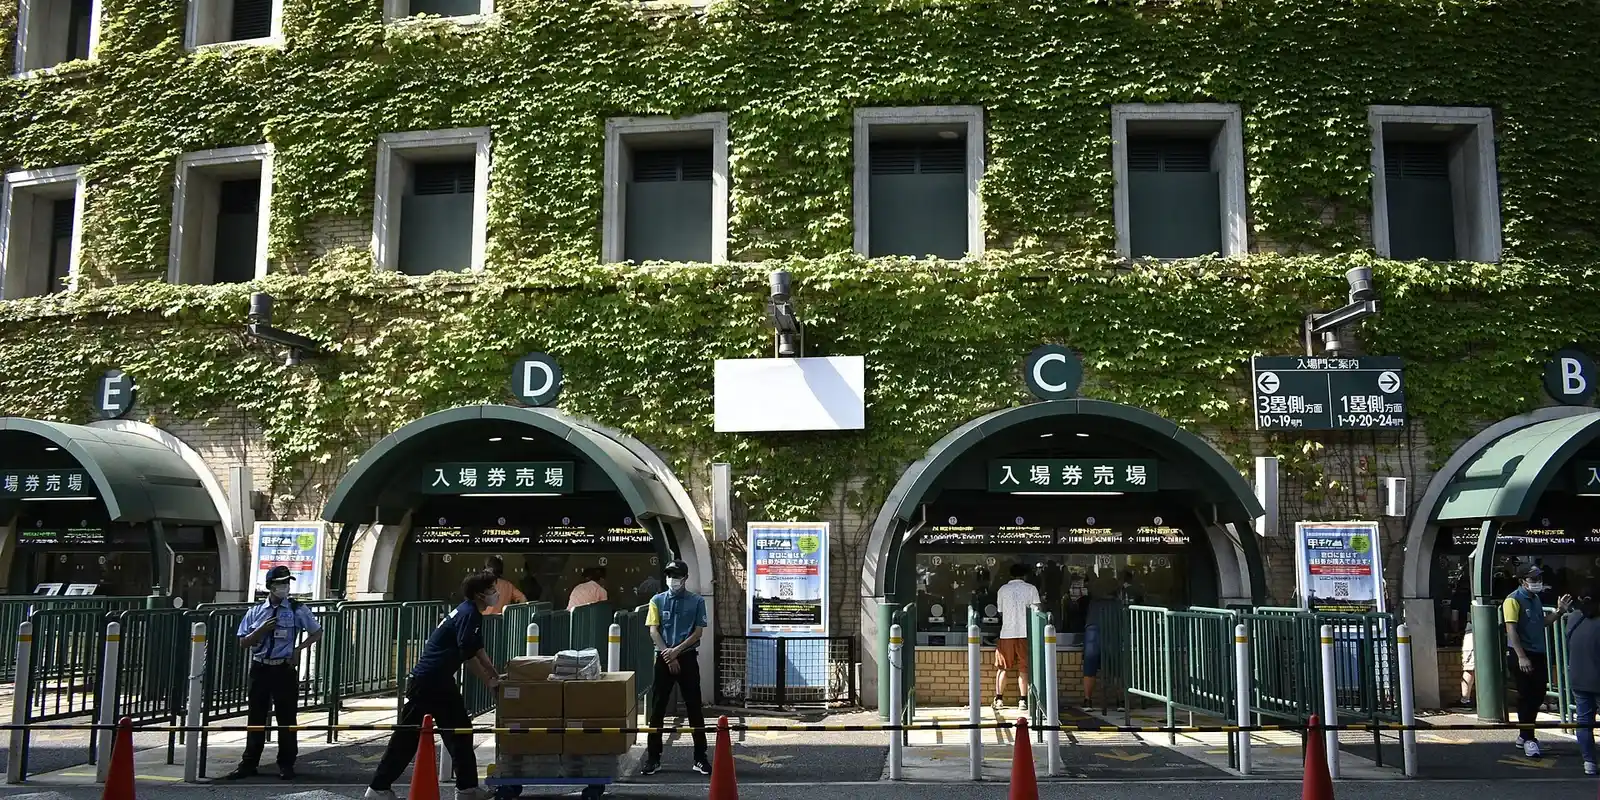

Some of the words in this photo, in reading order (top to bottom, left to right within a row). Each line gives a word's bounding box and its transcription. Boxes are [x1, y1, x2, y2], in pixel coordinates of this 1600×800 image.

[1033, 353, 1067, 392] C
[1297, 358, 1359, 370] 入場門ご案内
[523, 361, 554, 397] D
[1561, 357, 1586, 395] B
[103, 377, 122, 410] E
[1258, 395, 1322, 414] 3塁側方面
[1340, 395, 1403, 414] 1塁側方面
[4, 474, 82, 492] 場券売場
[432, 468, 564, 487] 入場券売場
[1000, 465, 1147, 486] 入場券売場
